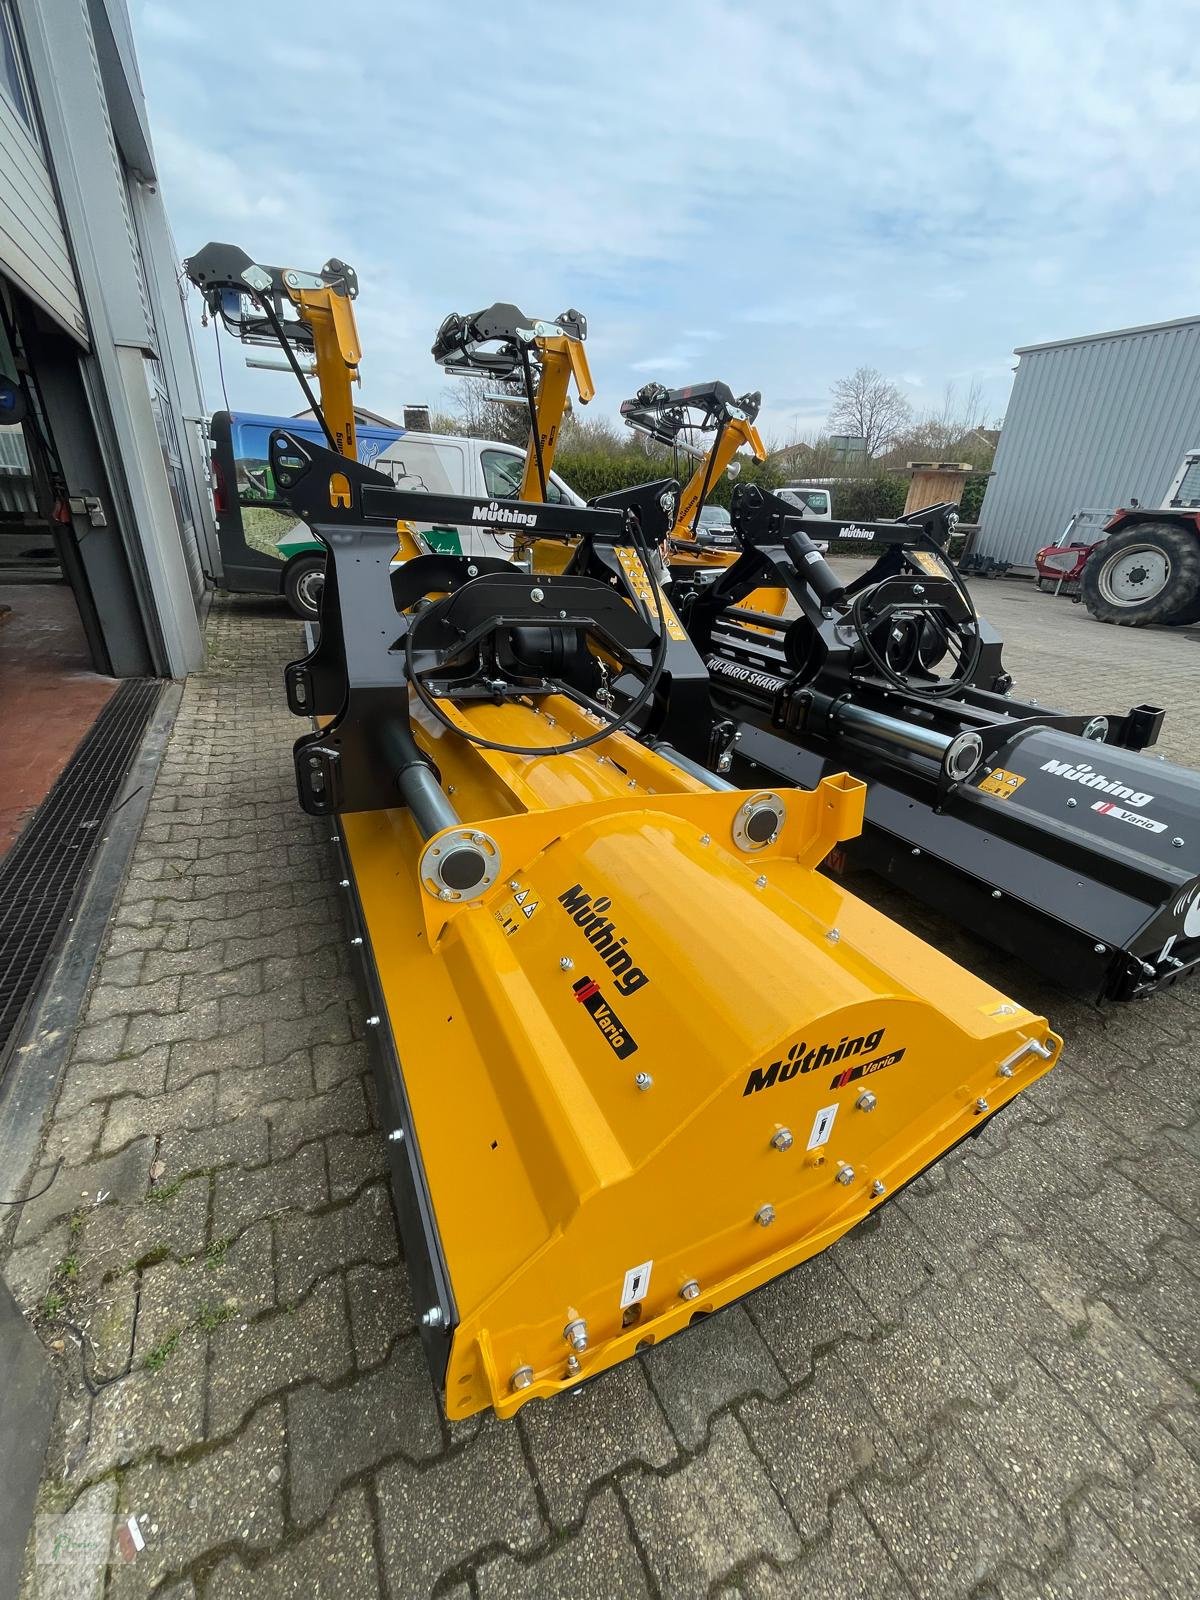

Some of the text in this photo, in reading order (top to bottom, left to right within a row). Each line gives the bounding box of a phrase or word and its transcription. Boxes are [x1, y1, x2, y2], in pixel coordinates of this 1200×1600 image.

[472, 501, 538, 527] Müthing
[839, 524, 875, 540] Müthing
[706, 658, 750, 681] MU-VARIO
[1040, 759, 1155, 807] Müthing
[1119, 812, 1155, 830] Vario
[557, 883, 650, 996] Müthing
[593, 1003, 625, 1048] Vario
[742, 1028, 886, 1097] Müthing
[861, 1055, 895, 1076] Vario
